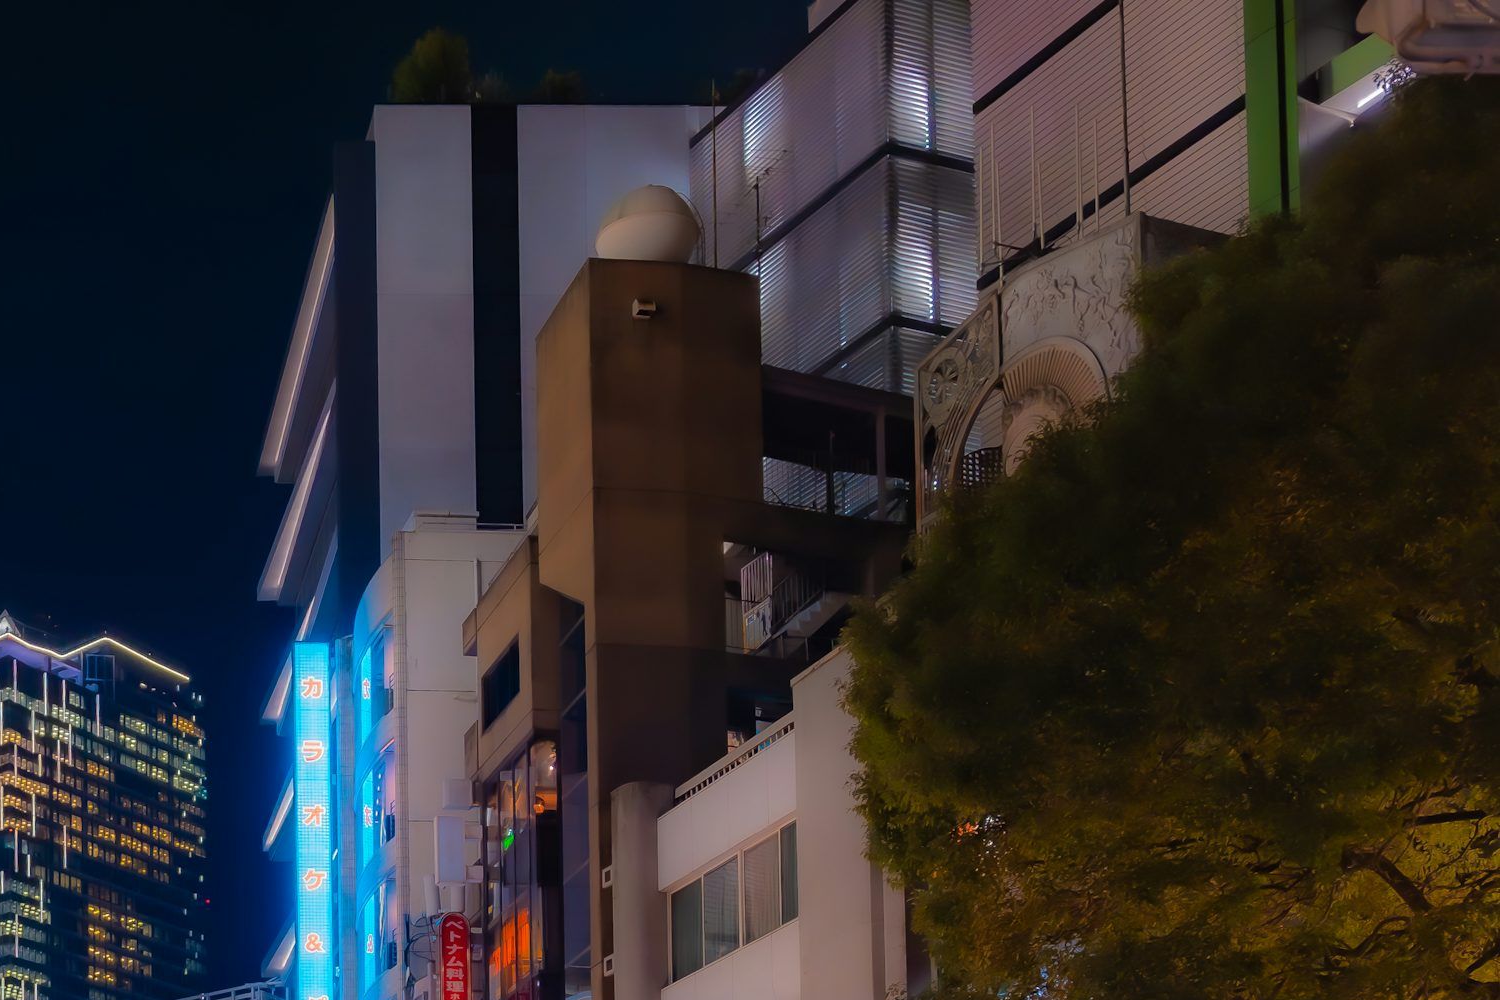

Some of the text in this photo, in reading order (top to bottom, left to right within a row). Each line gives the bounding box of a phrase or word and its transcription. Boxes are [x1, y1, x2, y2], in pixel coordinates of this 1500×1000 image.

[445, 920, 465, 993] ベトナム料理
